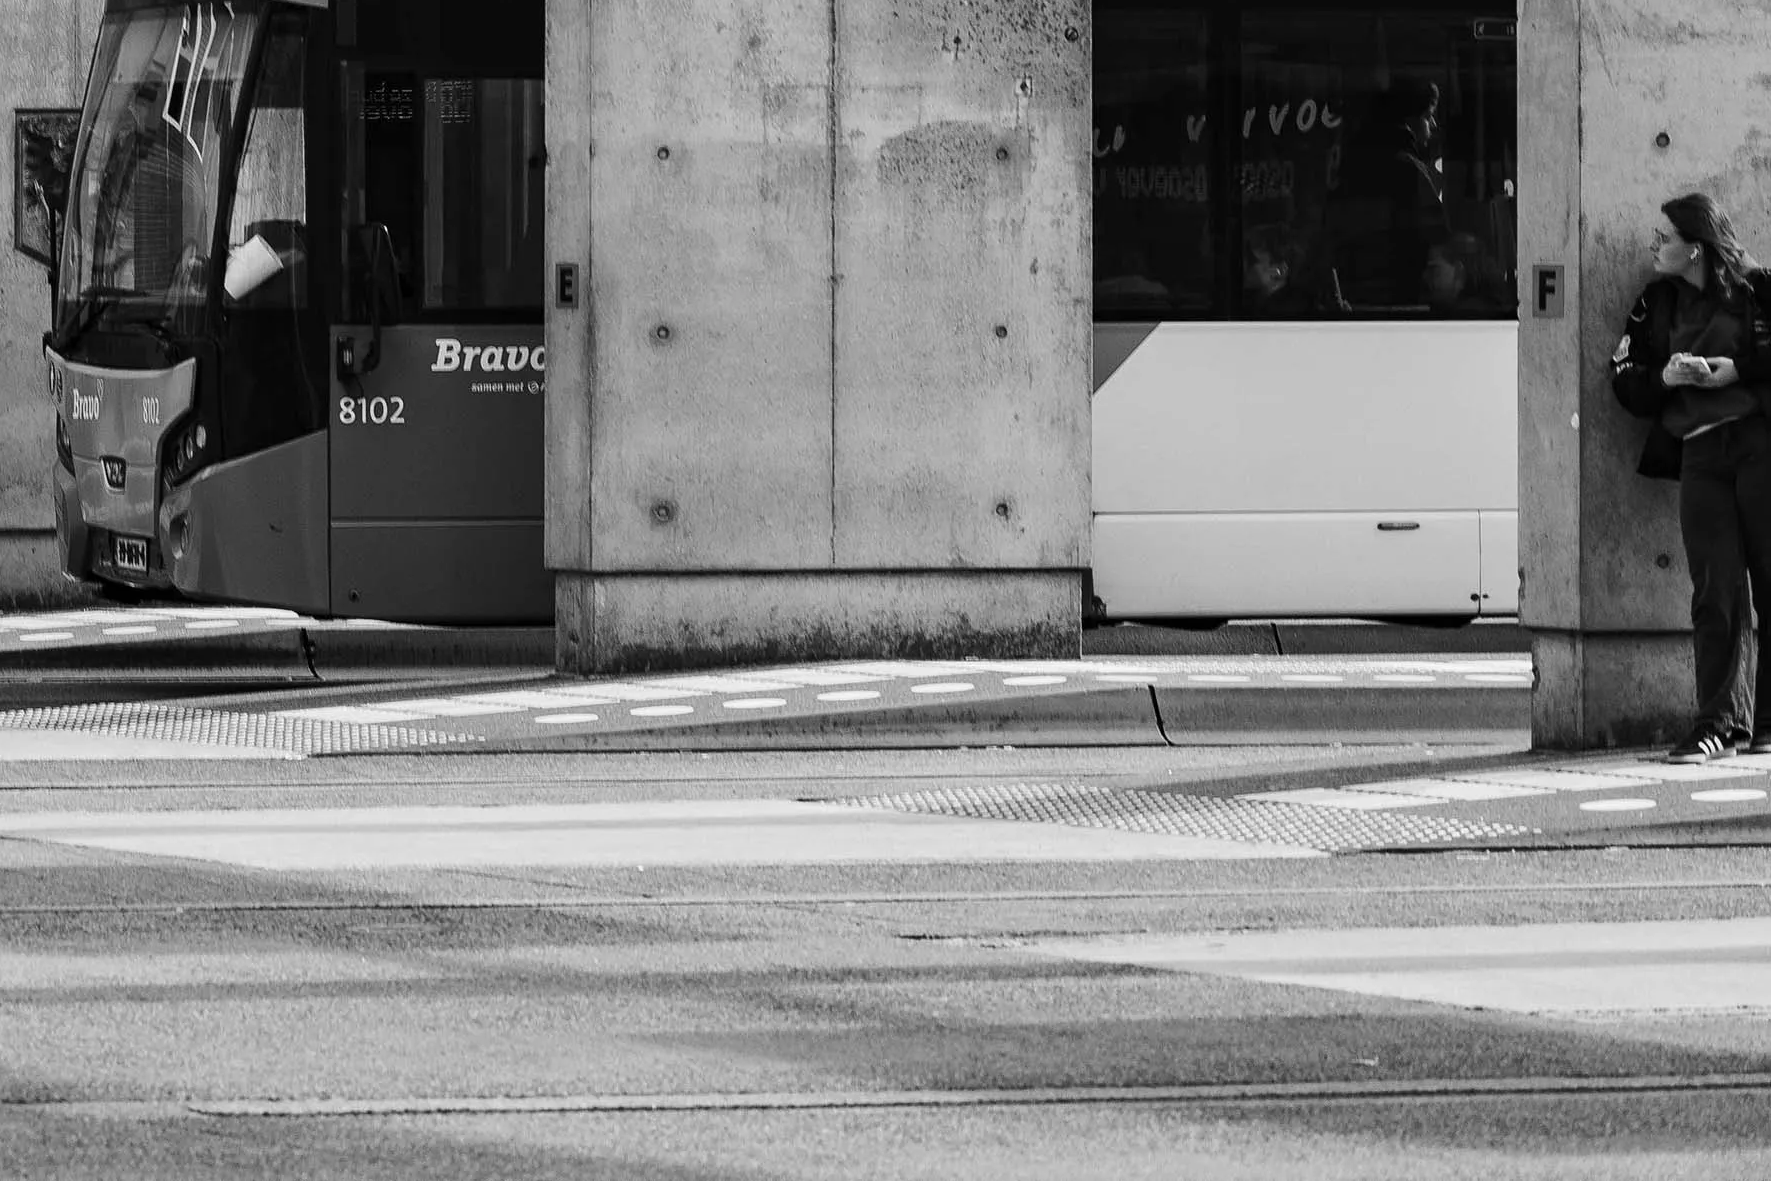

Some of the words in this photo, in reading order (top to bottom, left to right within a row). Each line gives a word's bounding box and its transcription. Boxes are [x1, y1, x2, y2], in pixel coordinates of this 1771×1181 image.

[559, 266, 573, 303] E
[1538, 270, 1556, 311] F
[72, 388, 100, 420] Bravo
[142, 395, 160, 425] 8102
[338, 395, 406, 425] 8102
